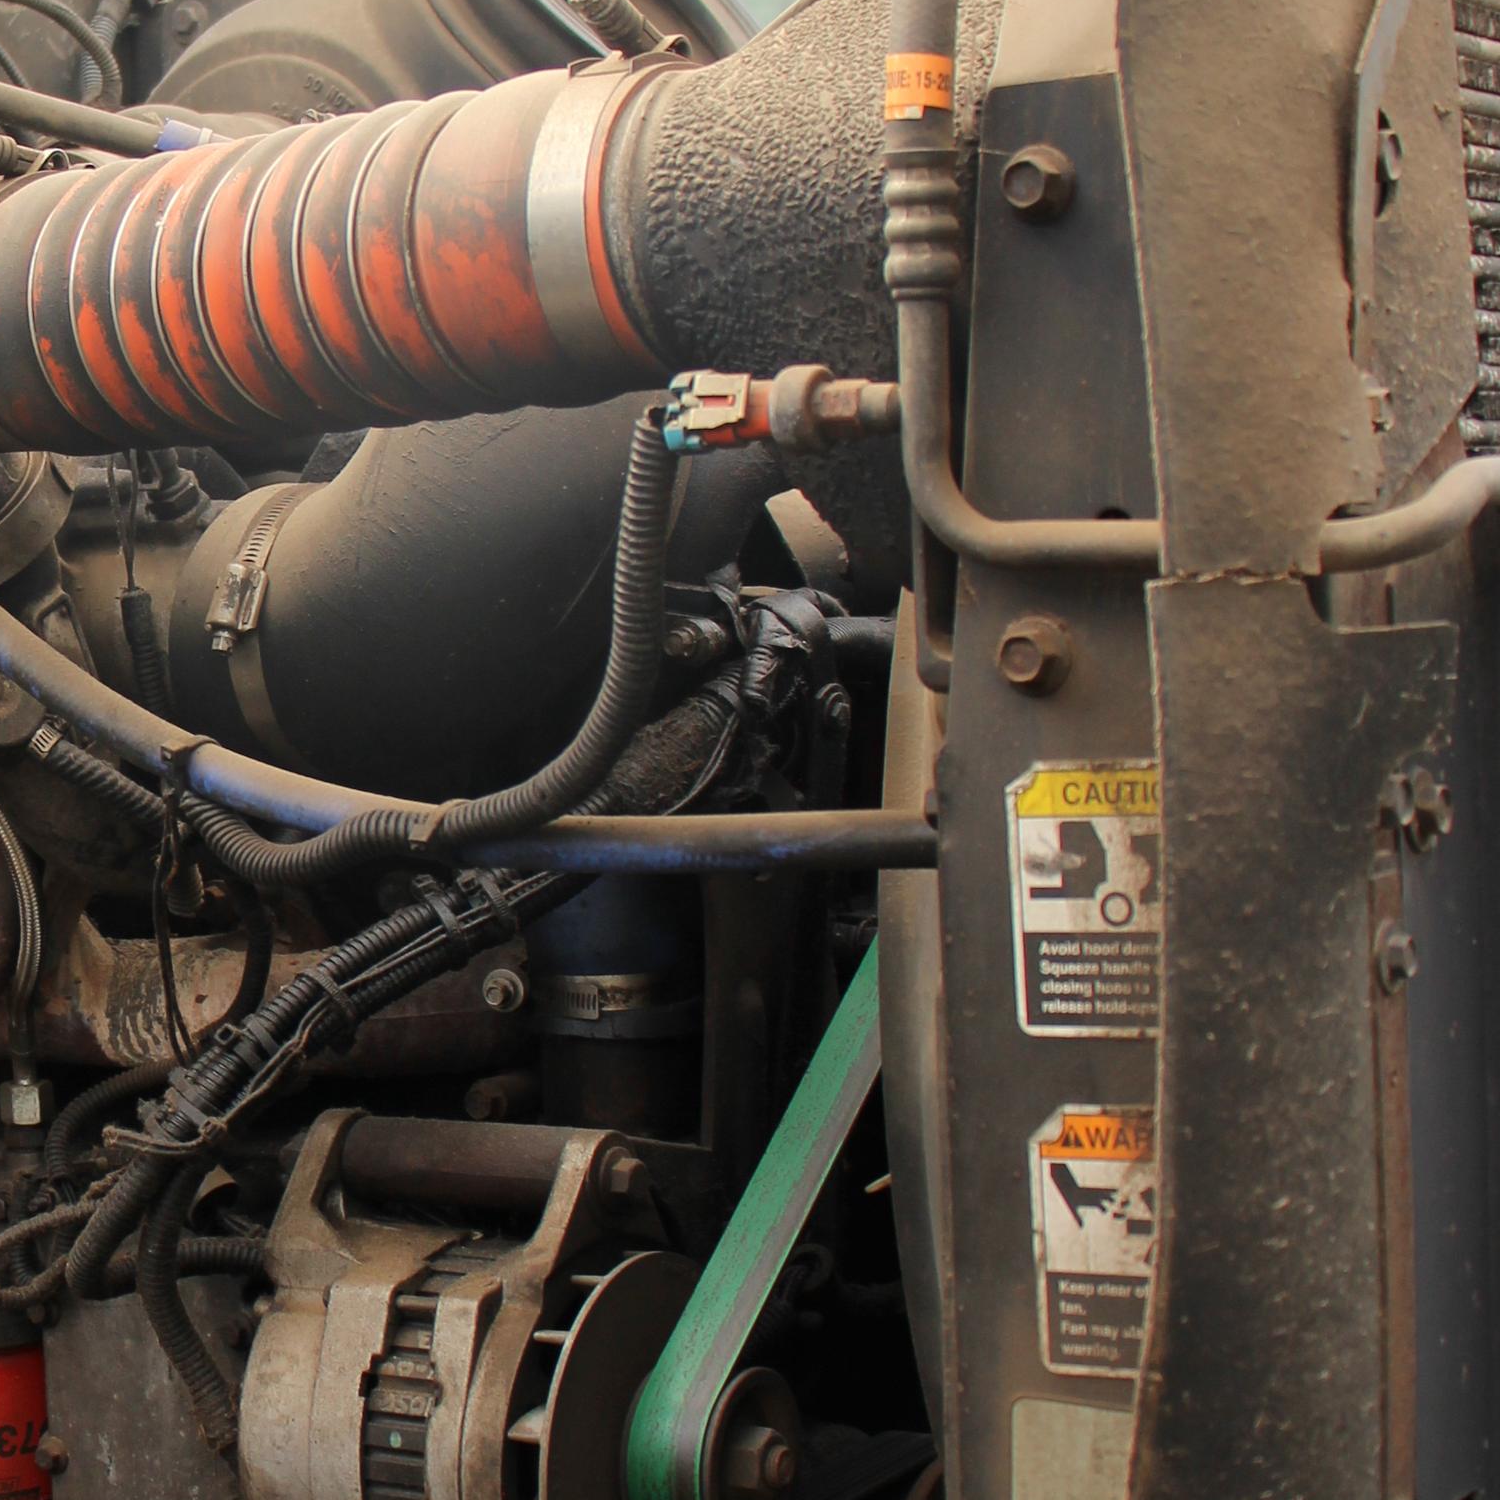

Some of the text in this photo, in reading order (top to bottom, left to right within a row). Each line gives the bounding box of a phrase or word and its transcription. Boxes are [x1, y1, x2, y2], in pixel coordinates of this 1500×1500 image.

[1062, 781, 1160, 805] CAUTI
[1039, 940, 1081, 956] Avoid
[1082, 940, 1120, 956] hood
[1039, 959, 1100, 977] Squeeze
[1039, 979, 1093, 997] closing
[1041, 998, 1093, 1013] release
[1058, 1279, 1095, 1298] Keep
[1096, 1282, 1132, 1297] clear
[1060, 1320, 1087, 1336] Fan
[1091, 1324, 1119, 1341] may
